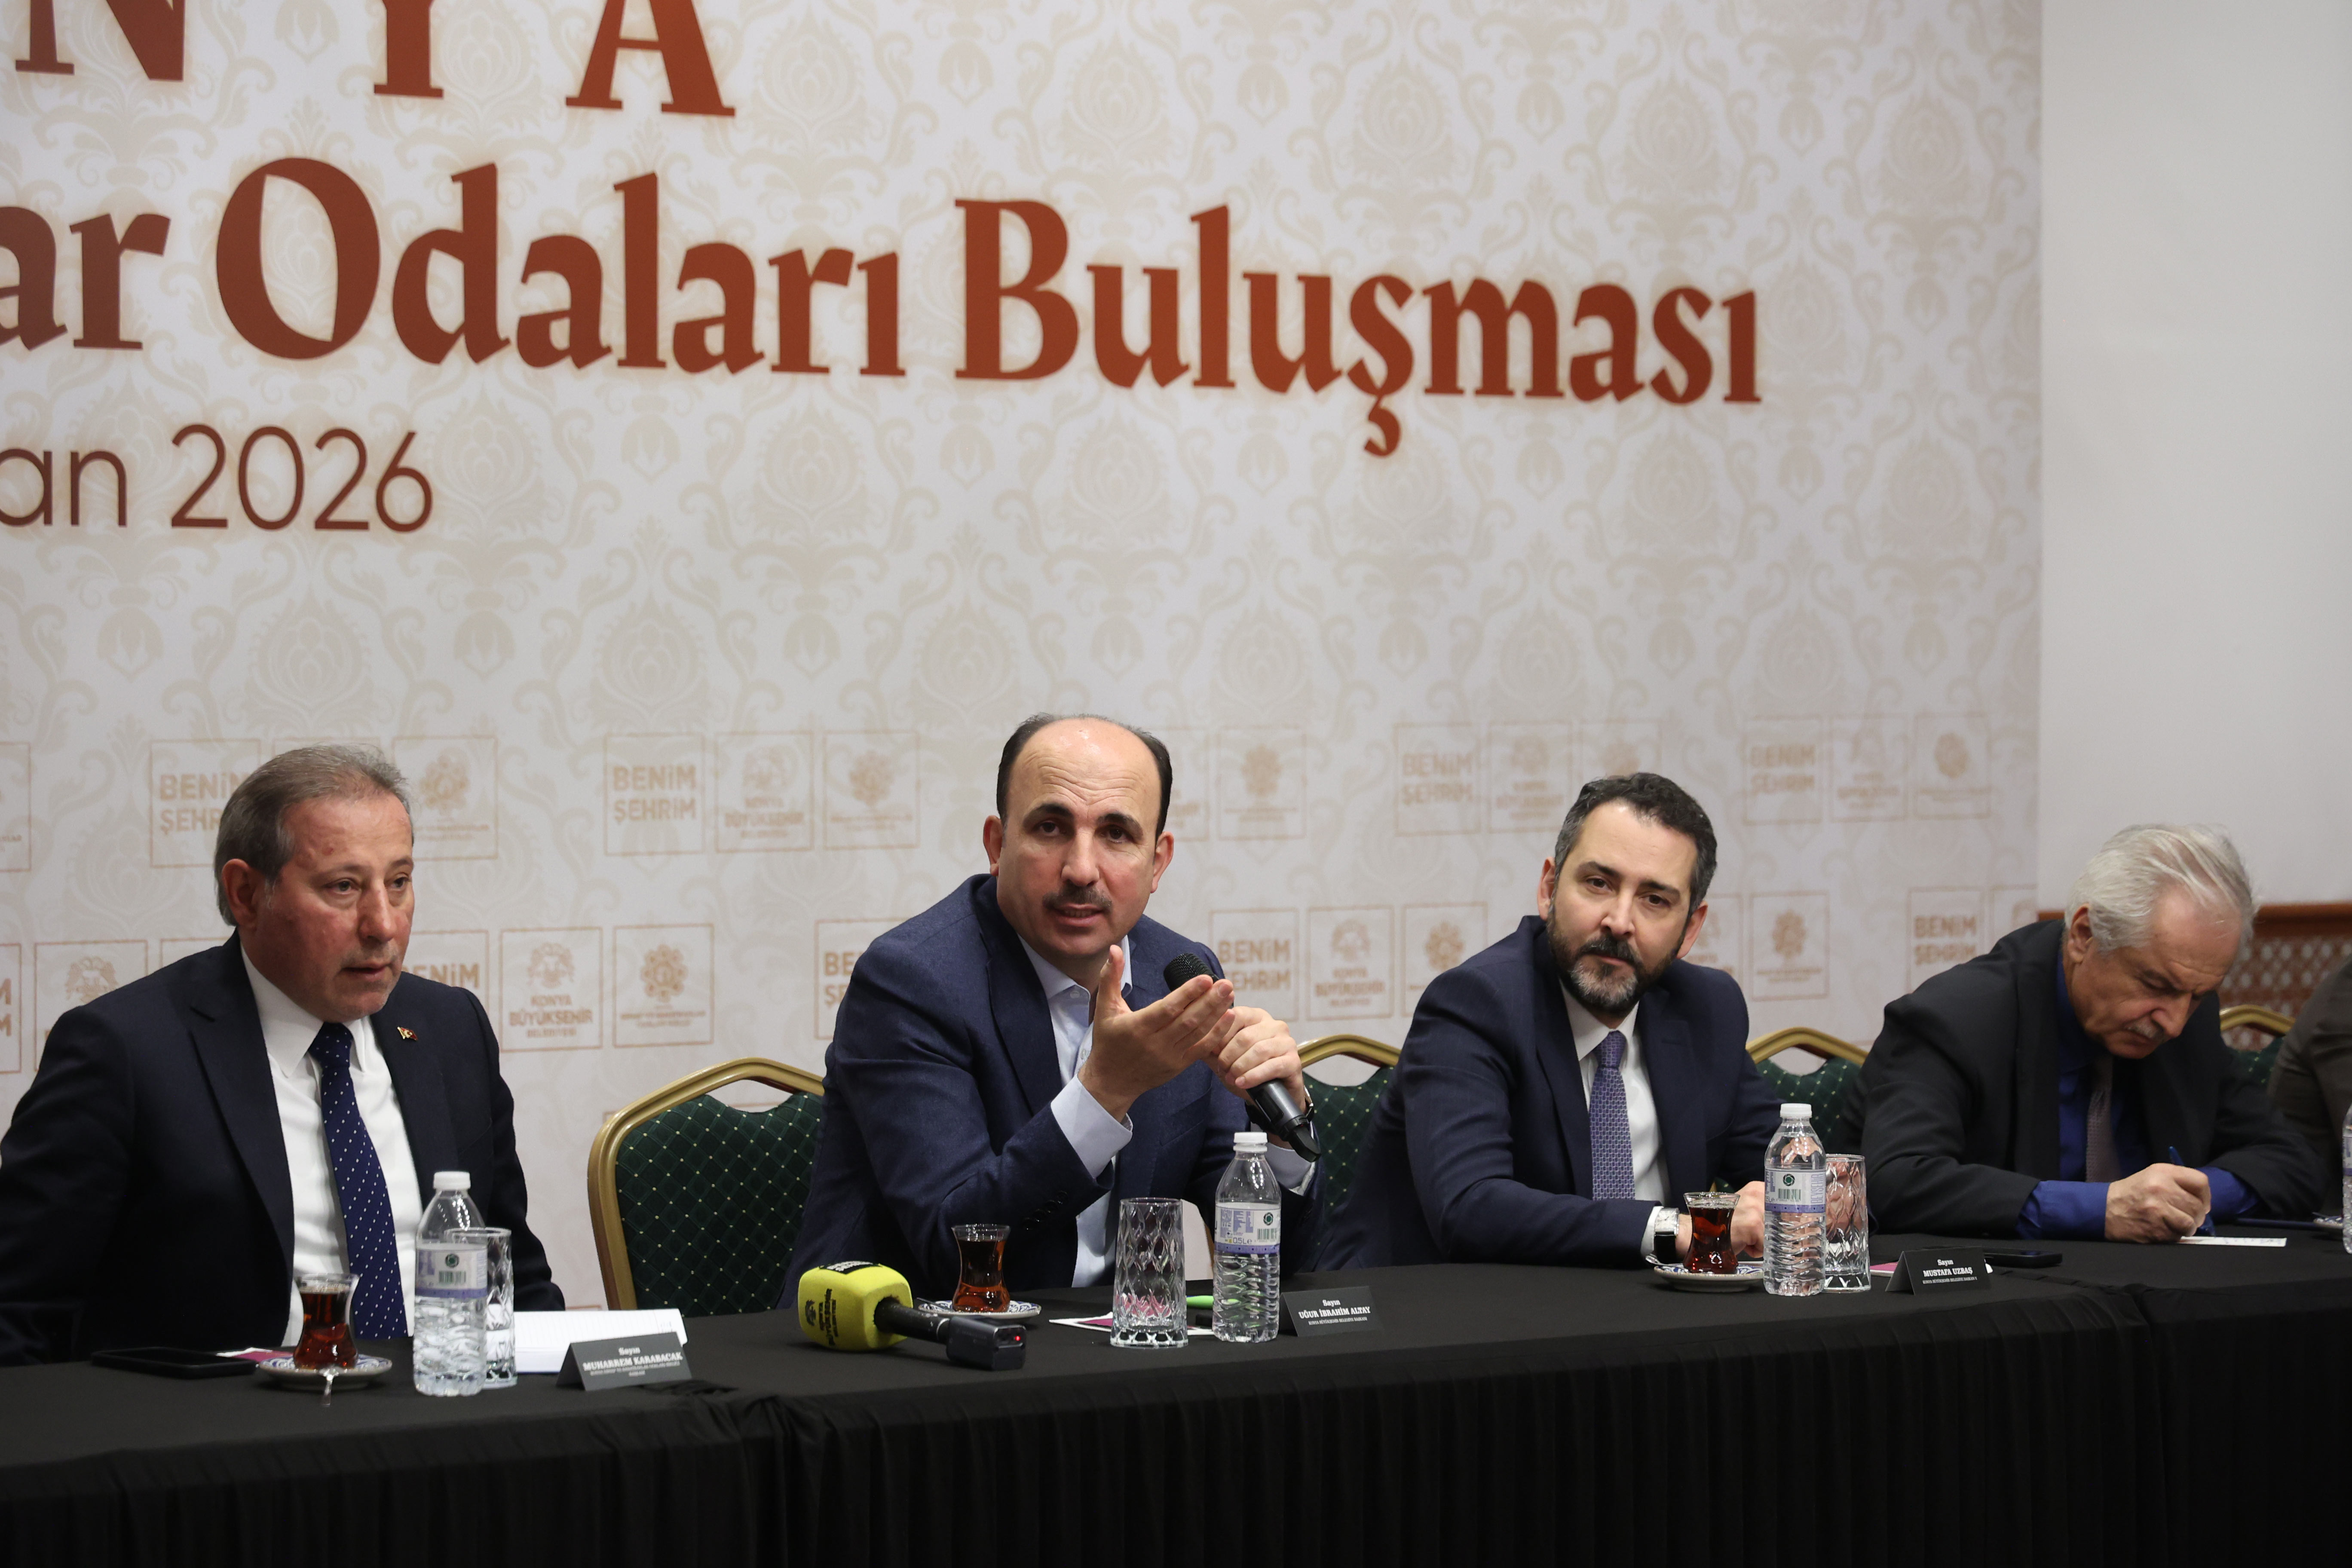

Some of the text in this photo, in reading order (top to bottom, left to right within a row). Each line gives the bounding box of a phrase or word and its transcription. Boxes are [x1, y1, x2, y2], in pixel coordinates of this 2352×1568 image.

[215, 156, 907, 378] Odaları
[954, 198, 1762, 459] Buluşması
[0, 423, 434, 533] an 2026
[613, 764, 696, 791] BENİM
[613, 797, 696, 824] ŞEHRİM
[1915, 915, 1977, 938] BENİM
[1219, 939, 1290, 963] BENİM
[402, 963, 479, 989] ENİM
[1225, 969, 1291, 991] EHRİM
[1923, 1267, 1973, 1277] MUSTAFA UZBAŞ
[1298, 1306, 1371, 1319] UĞUR İBRAHİM ALTAY
[618, 1347, 640, 1356] Sayın
[583, 1357, 633, 1371] MUHARREM
